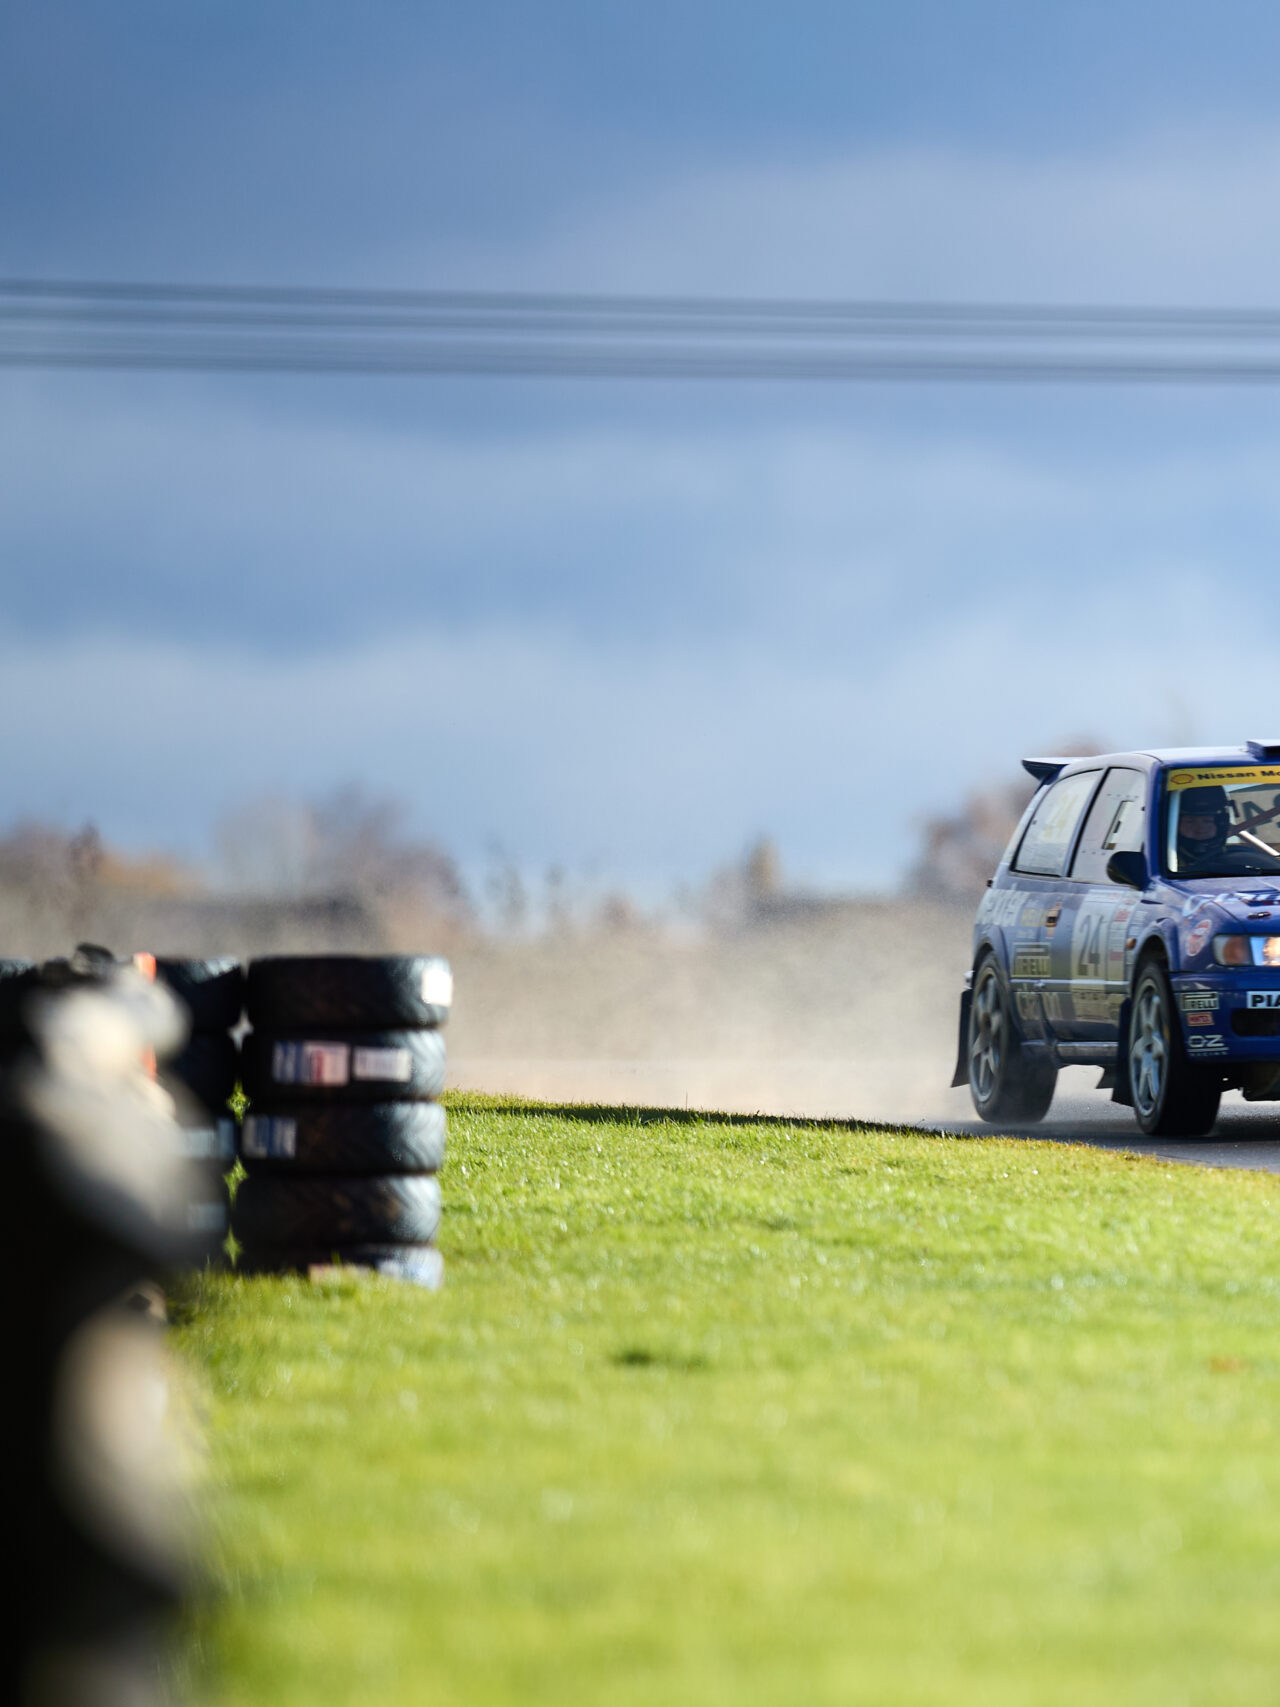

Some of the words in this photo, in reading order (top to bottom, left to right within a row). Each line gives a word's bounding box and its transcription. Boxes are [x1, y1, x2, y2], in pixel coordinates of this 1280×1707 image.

[1197, 770, 1256, 780] Nissan
[1078, 914, 1105, 977] 24
[1188, 1034, 1225, 1048] OZ
